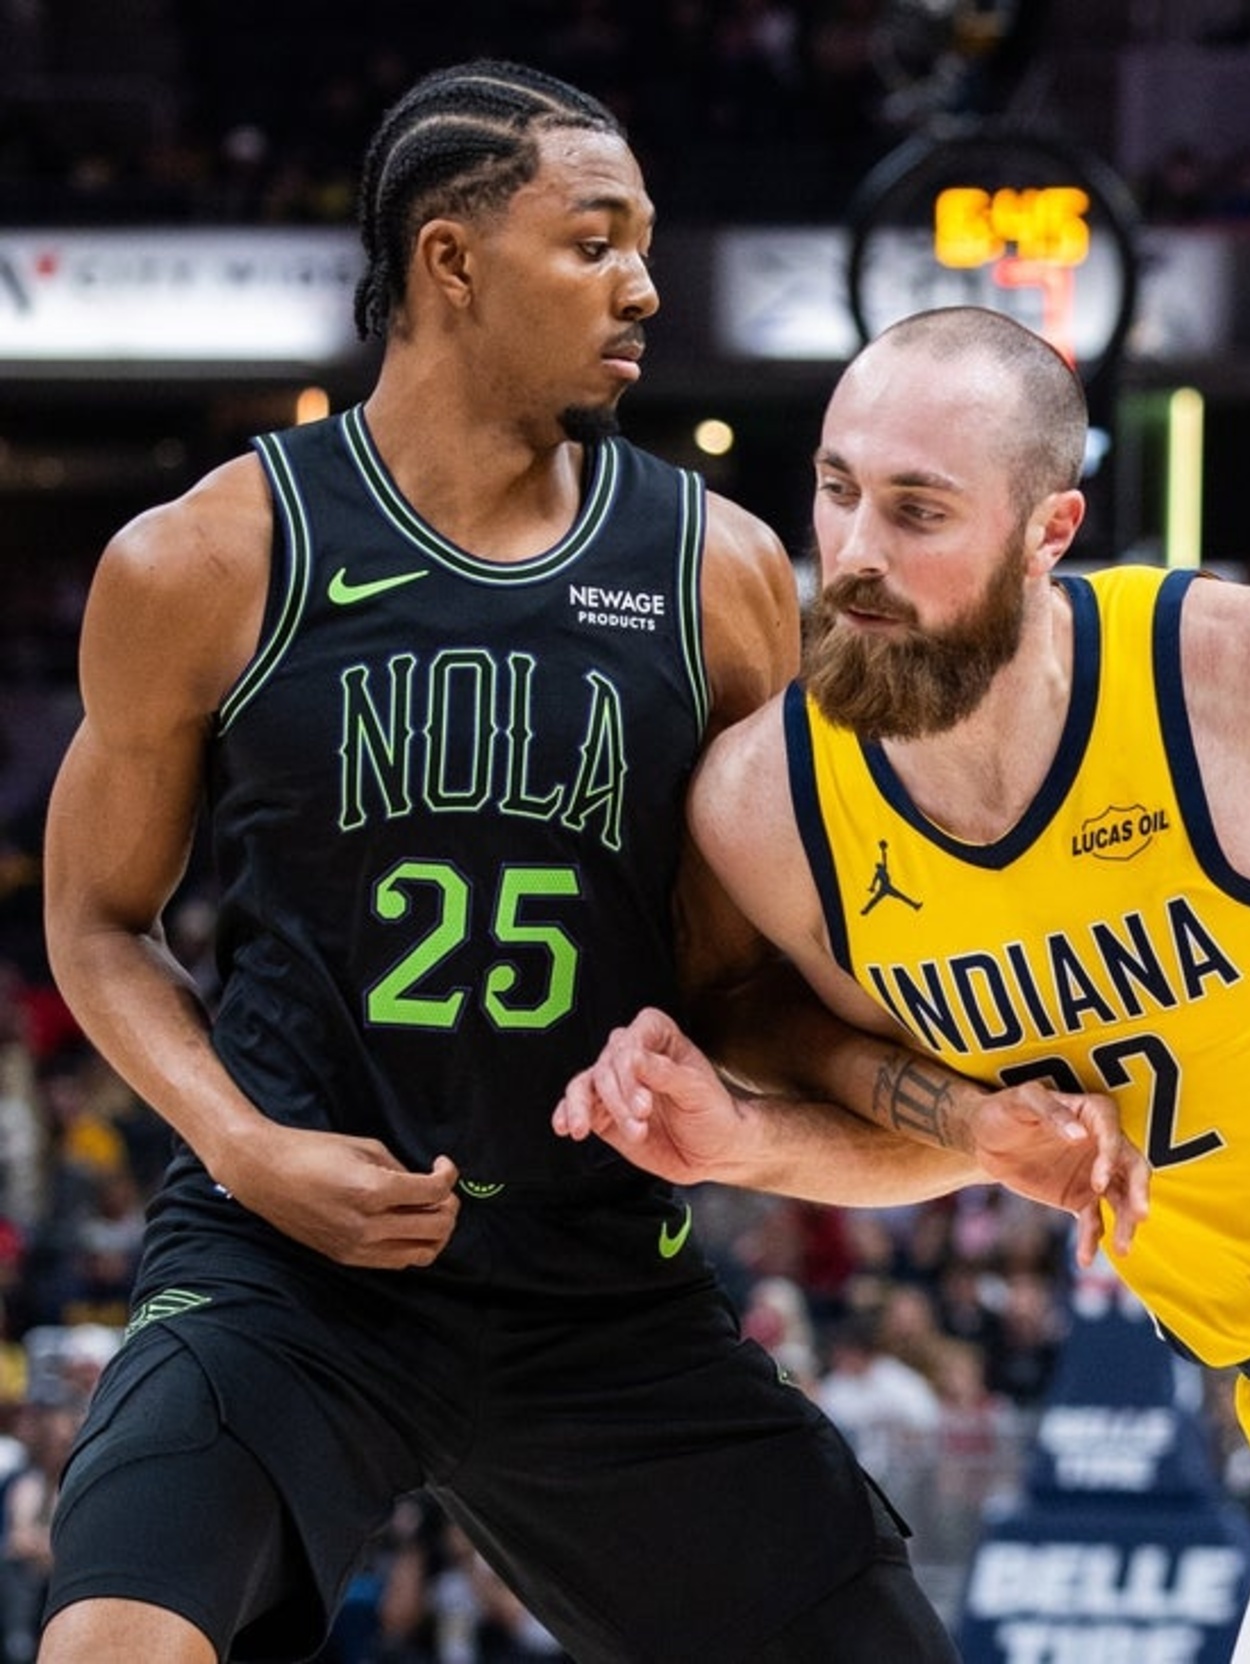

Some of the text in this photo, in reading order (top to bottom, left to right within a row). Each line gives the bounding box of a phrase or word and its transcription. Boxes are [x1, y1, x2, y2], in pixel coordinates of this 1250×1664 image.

[569, 584, 665, 615] NEWAGE
[578, 611, 656, 631] PRODUCTS
[338, 648, 628, 852] NOLA
[1072, 810, 1169, 856] LUCAS OIL
[367, 861, 580, 1029] 25
[866, 896, 1241, 1054] INDIANA
[968, 1541, 1246, 1626] BELLE
